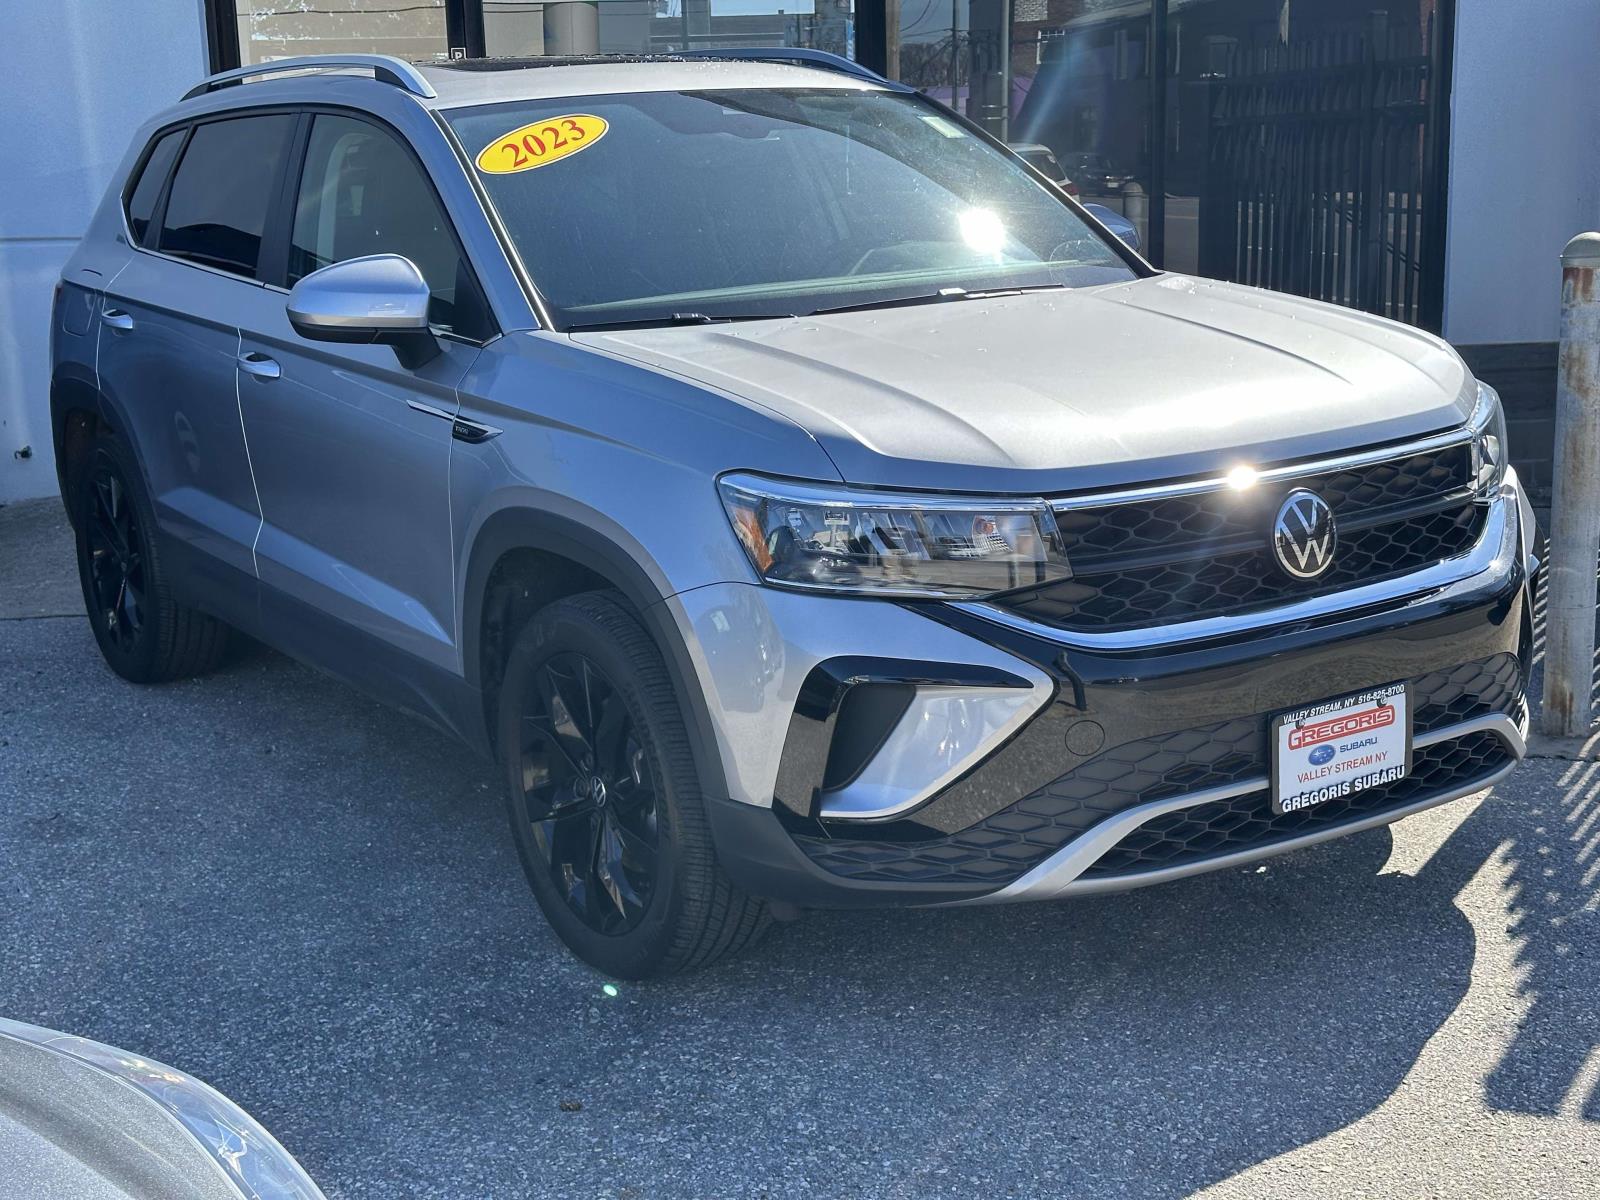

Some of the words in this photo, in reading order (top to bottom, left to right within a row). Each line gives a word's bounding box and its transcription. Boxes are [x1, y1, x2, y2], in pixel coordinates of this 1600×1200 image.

[501, 119, 585, 168] 2023
[1275, 491, 1336, 577] VW
[1283, 710, 1310, 724] VALLEY
[1344, 697, 1355, 707] NY
[1358, 684, 1404, 704] 516-825-8700
[1289, 708, 1394, 750] GREGORIS
[1339, 737, 1378, 753] SUBARU
[1297, 765, 1333, 784] VALLEY
[1334, 756, 1373, 774] STREAM
[1375, 751, 1388, 762] NY
[1282, 782, 1350, 813] GREGORIS
[1354, 765, 1405, 791] SUBARU
